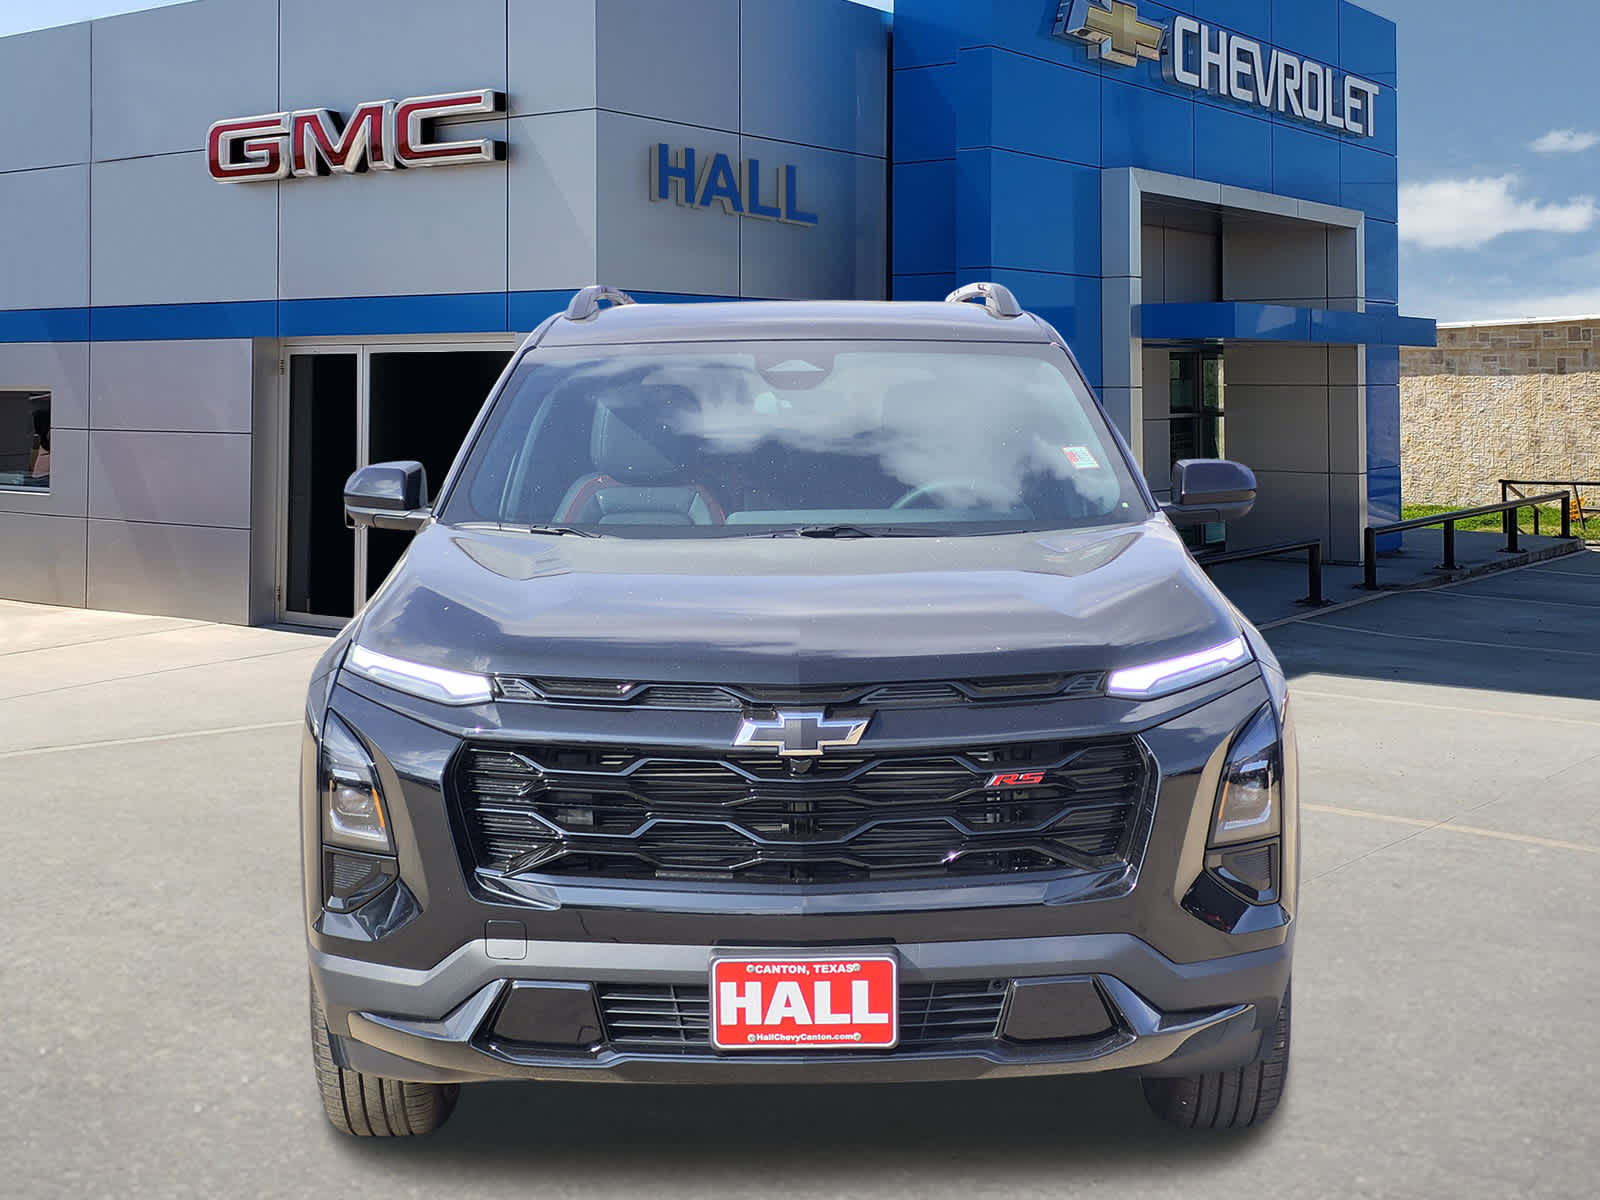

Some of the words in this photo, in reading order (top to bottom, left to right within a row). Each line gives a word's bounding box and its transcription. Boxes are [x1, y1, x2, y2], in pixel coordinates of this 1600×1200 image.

[1174, 16, 1379, 137] CHEVROLET
[208, 89, 505, 183] GMC
[652, 143, 818, 225] HALL
[988, 772, 1045, 787] RS
[755, 964, 810, 975] CANTON,
[813, 963, 854, 974] TEXAS
[719, 980, 889, 1025] HALL
[756, 1033, 854, 1043] HallChevyCanton.com
